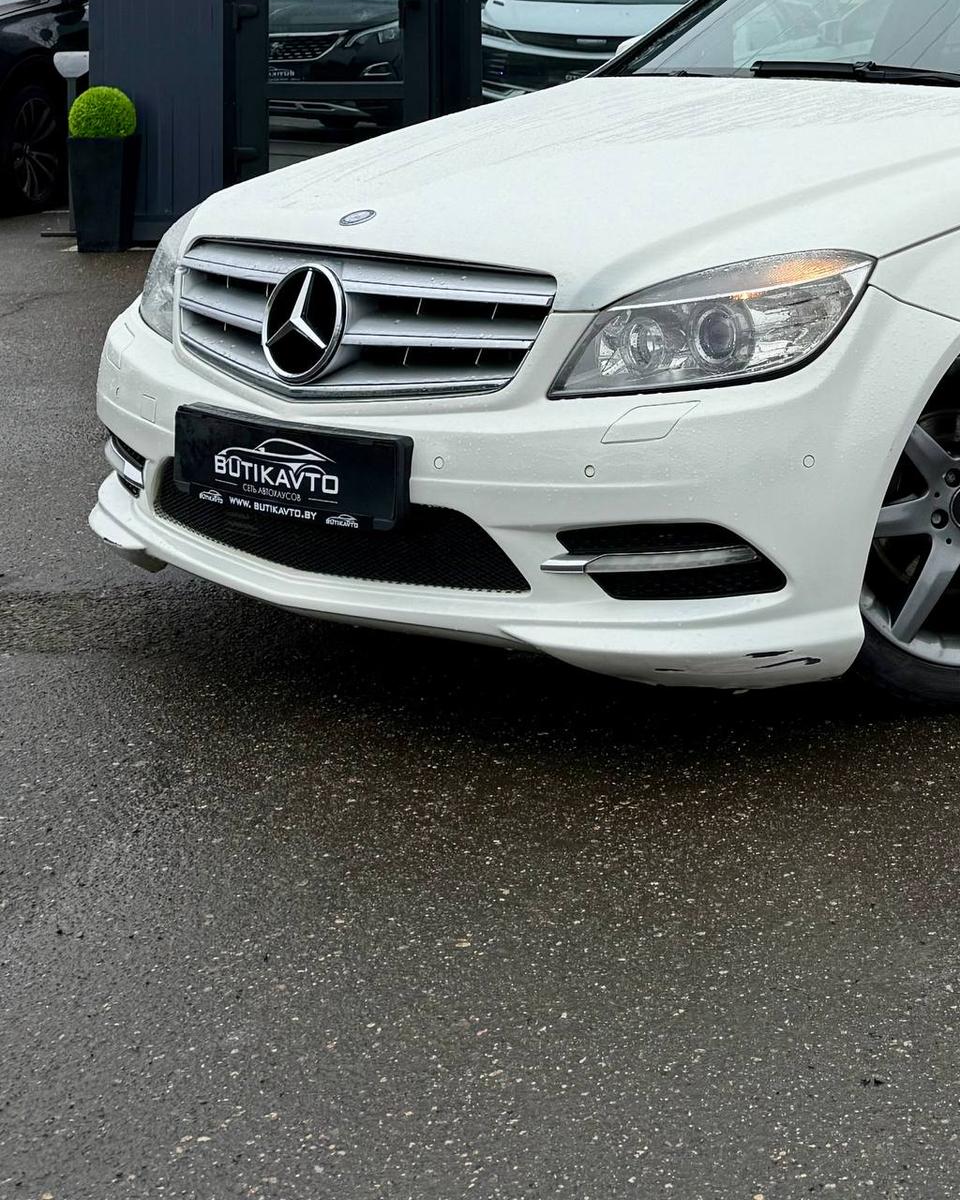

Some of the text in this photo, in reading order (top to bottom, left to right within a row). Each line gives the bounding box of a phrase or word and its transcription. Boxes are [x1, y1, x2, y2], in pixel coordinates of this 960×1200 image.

[214, 455, 339, 495] BUTIKAVTO
[242, 483, 302, 502] СЕТЬ АВТОХАУСОВ
[229, 496, 317, 521] WWW. BUTIKAVTO.BY
